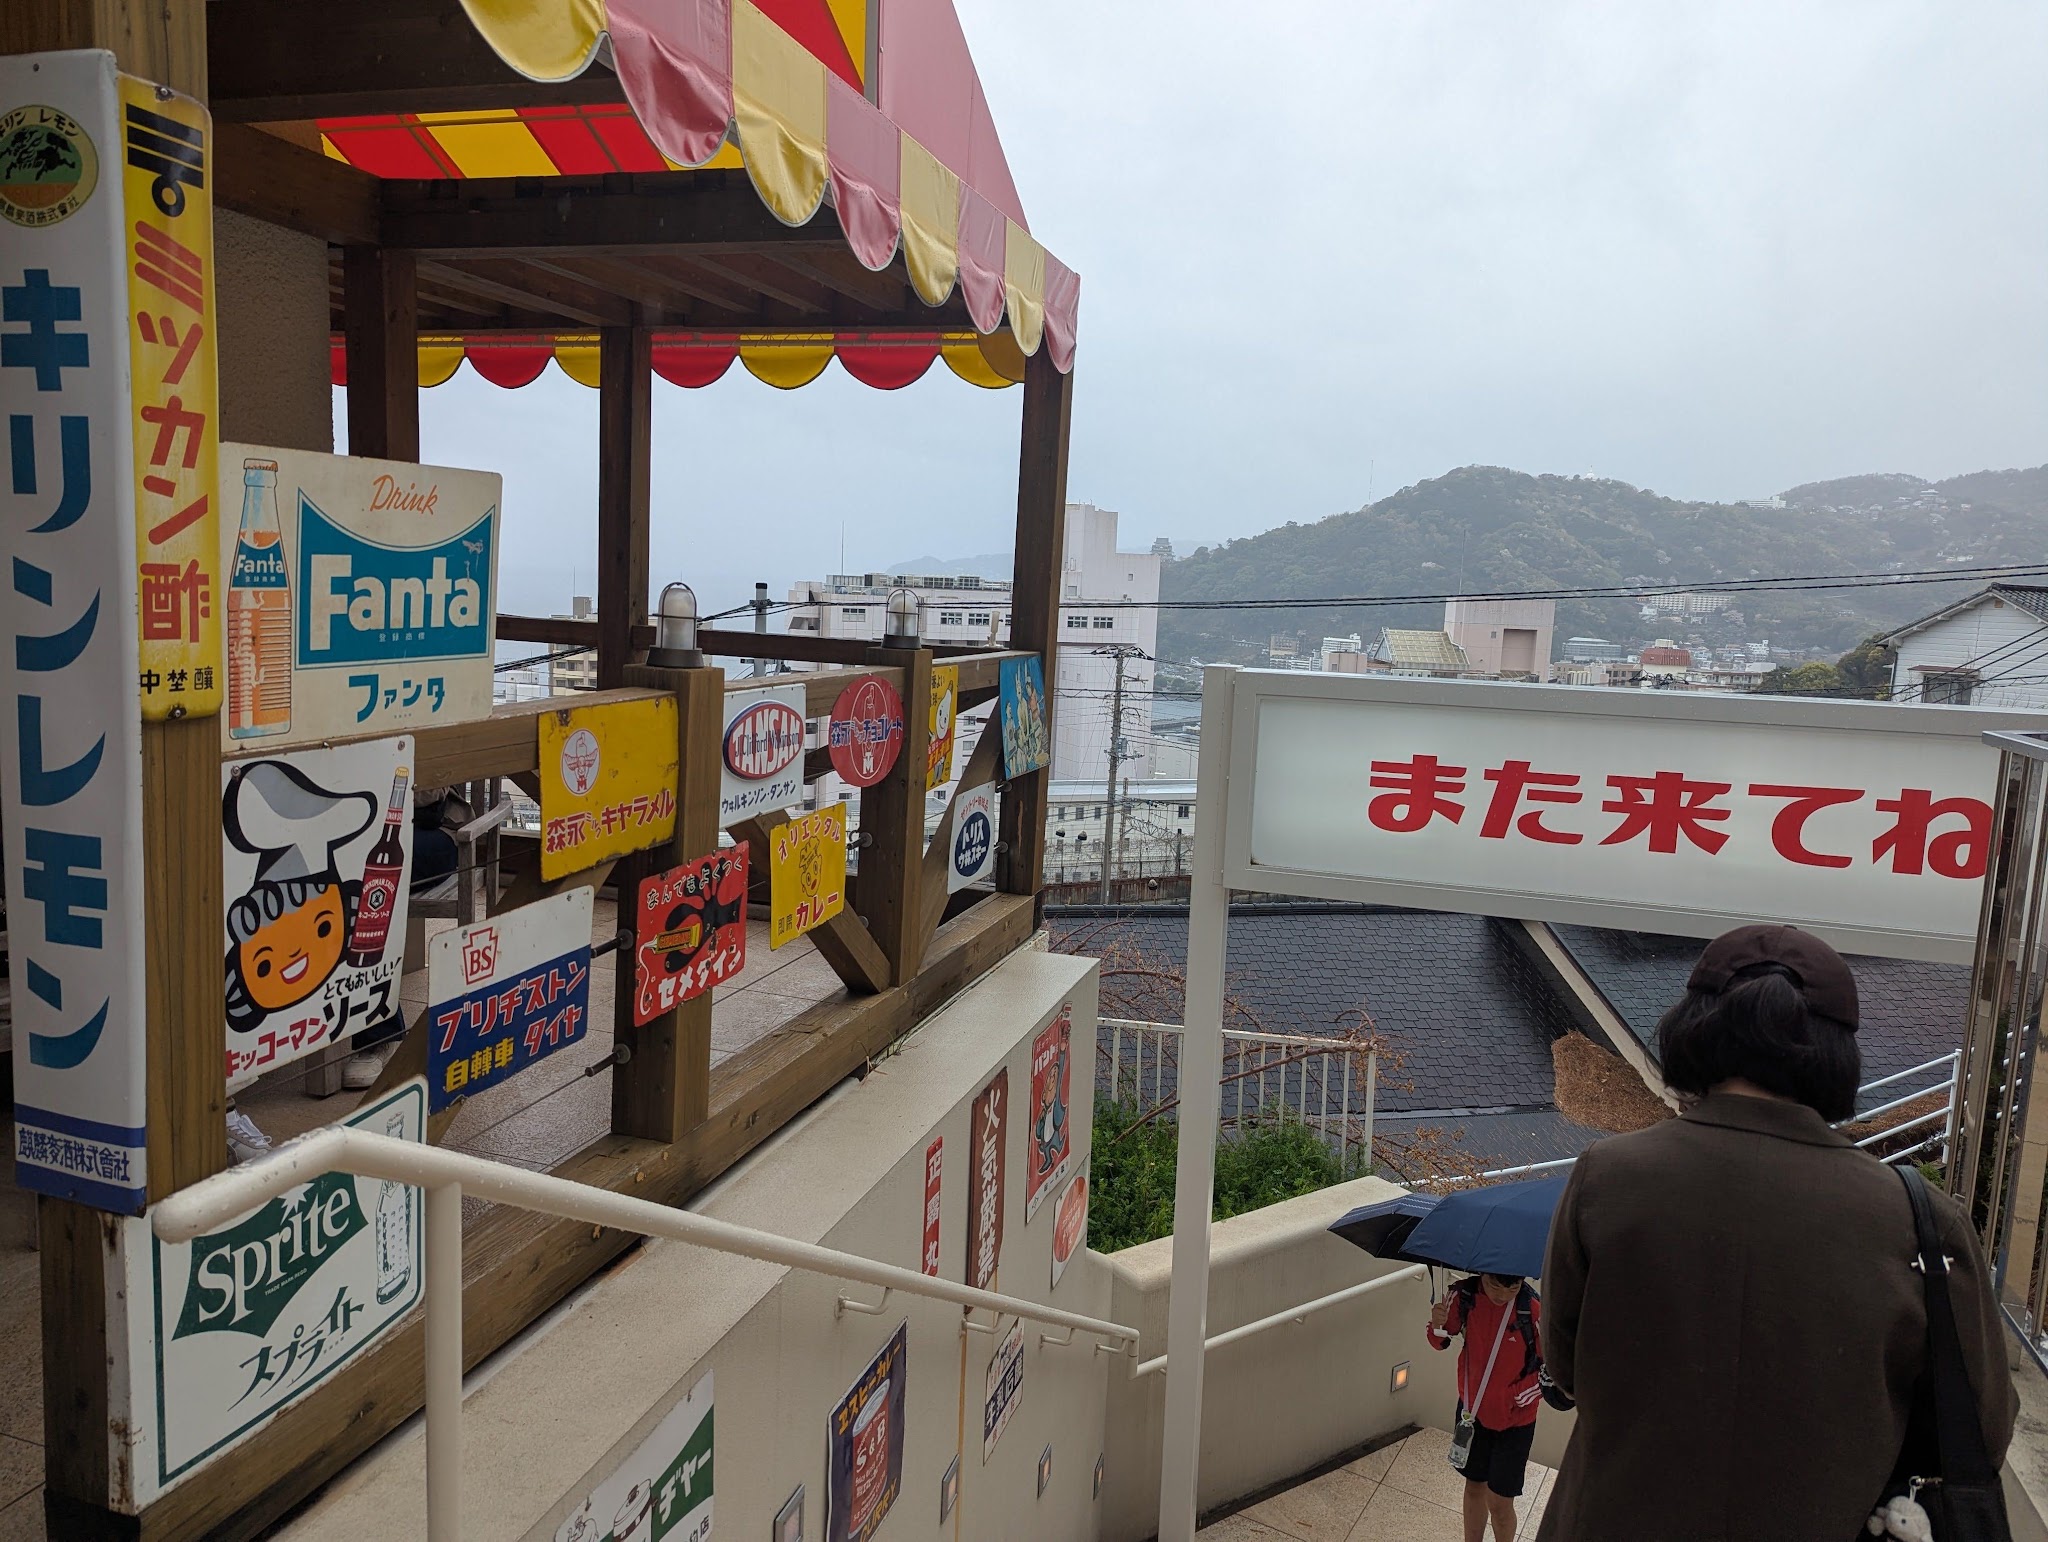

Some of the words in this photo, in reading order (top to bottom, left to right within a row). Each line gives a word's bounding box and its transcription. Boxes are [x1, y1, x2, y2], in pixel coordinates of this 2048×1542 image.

[39, 108, 80, 137] レモン
[369, 474, 439, 516] Drink
[234, 553, 285, 577] Fanta
[309, 553, 481, 652] Fanta
[1, 268, 110, 1070] キリンレモン
[348, 673, 446, 724] ファンタ
[732, 708, 801, 775] TANSAN
[778, 814, 841, 865] オリエンタル
[961, 818, 985, 851] トリス
[1367, 753, 2000, 880] また来てね
[646, 856, 743, 911] なんでもよくつく
[795, 892, 839, 933] カレー
[469, 945, 493, 977] BS
[322, 978, 393, 1044] ソース
[523, 1003, 584, 1057] タイヤ
[923, 1147, 943, 1277] 正露丸
[197, 1186, 352, 1328] Sprite
[227, 1286, 365, 1412] スプライト
